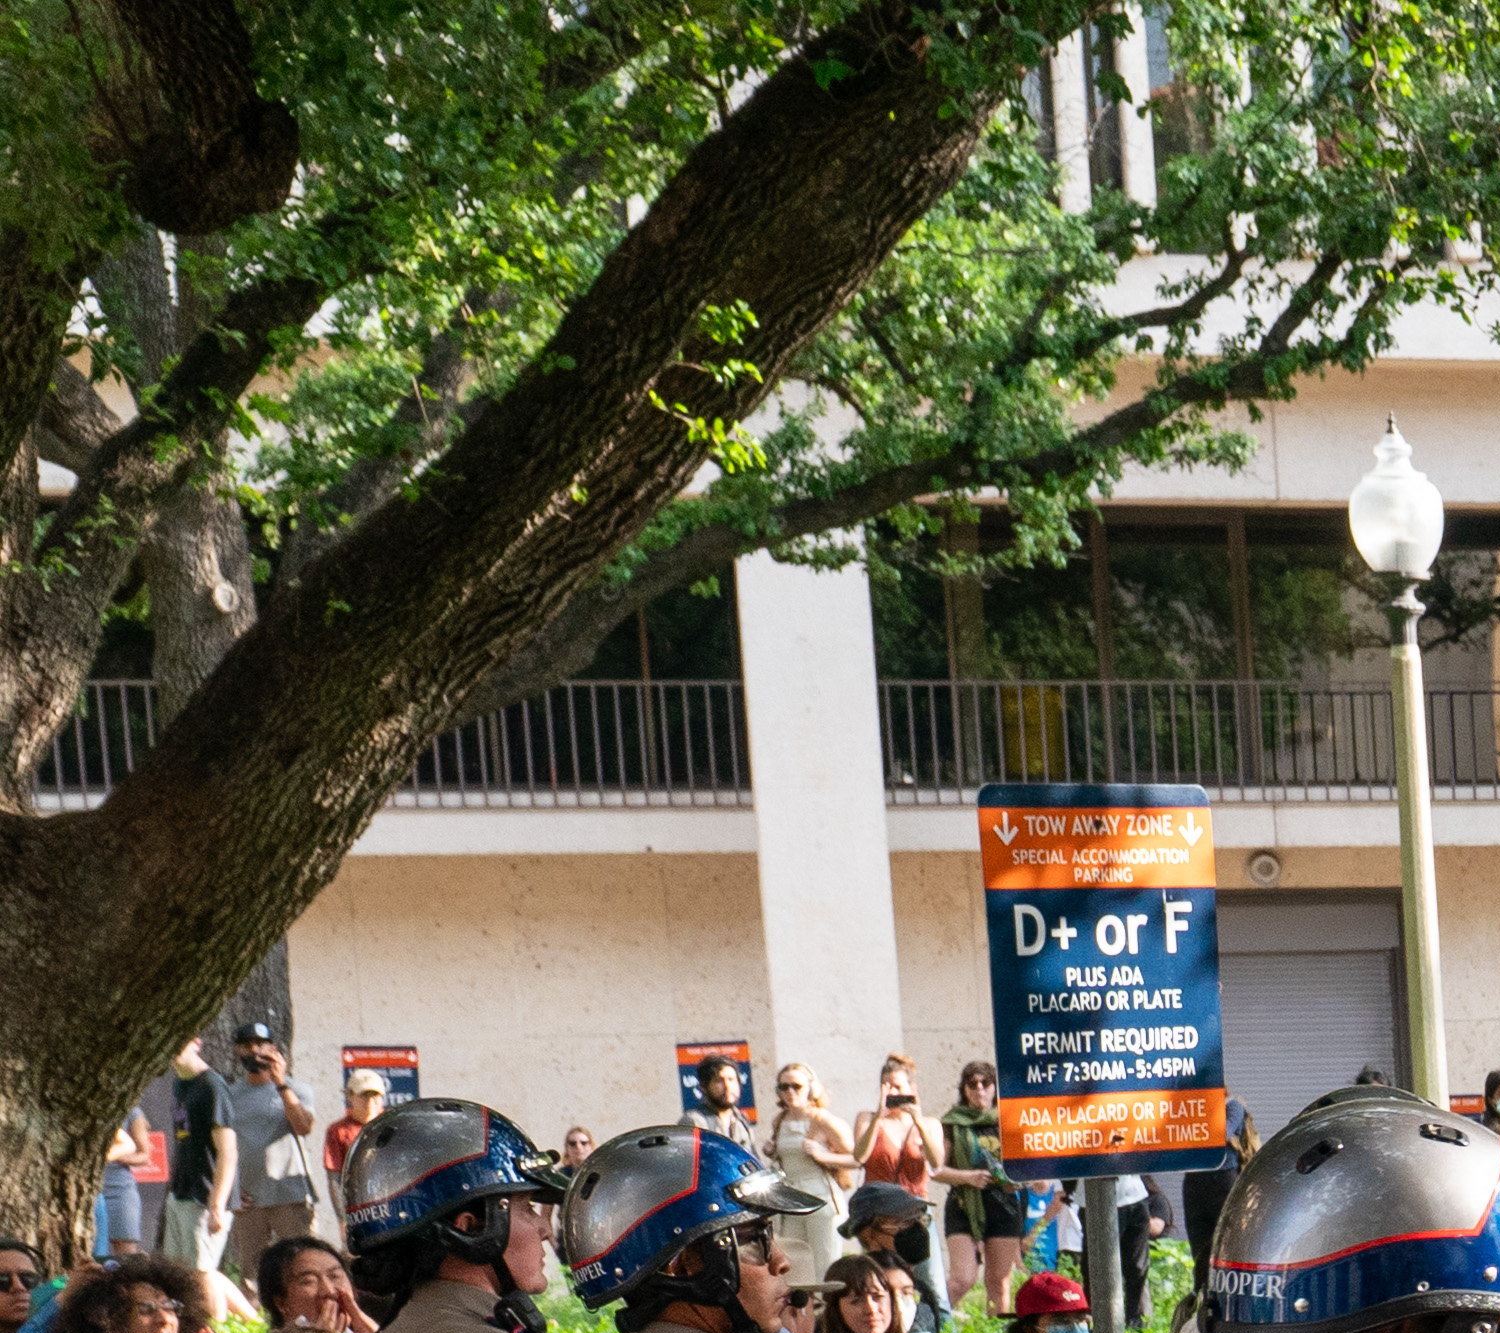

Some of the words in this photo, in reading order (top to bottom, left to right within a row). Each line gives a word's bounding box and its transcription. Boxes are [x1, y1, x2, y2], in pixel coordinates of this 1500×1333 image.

[1024, 815, 1067, 837] TOW
[1071, 815, 1120, 836] AWAY
[1126, 814, 1174, 836] ZONE
[1012, 849, 1067, 865] SPECIAL
[1072, 848, 1189, 864] ACCOMMODATION
[1074, 867, 1133, 884] PARKING
[1013, 903, 1078, 957] D+
[1095, 913, 1148, 955] or
[1164, 900, 1193, 954] F
[1066, 966, 1107, 987] PLUS
[1110, 966, 1144, 986] ADA
[1029, 991, 1101, 1013] PLACARD
[1105, 990, 1130, 1011] OR
[1133, 989, 1183, 1010] PLATE
[1021, 1030, 1095, 1056] PERMIT
[1101, 1026, 1198, 1054] REQUIRED
[1027, 1063, 1058, 1084] M-F
[1019, 1107, 1054, 1128] ADA
[1056, 1103, 1128, 1126] PLACARD
[1132, 1102, 1156, 1121] OR
[1160, 1099, 1206, 1122] PLATE
[1023, 1130, 1102, 1153] REQUIRED
[1132, 1127, 1161, 1146] ALL
[1166, 1123, 1210, 1143] TIMES
